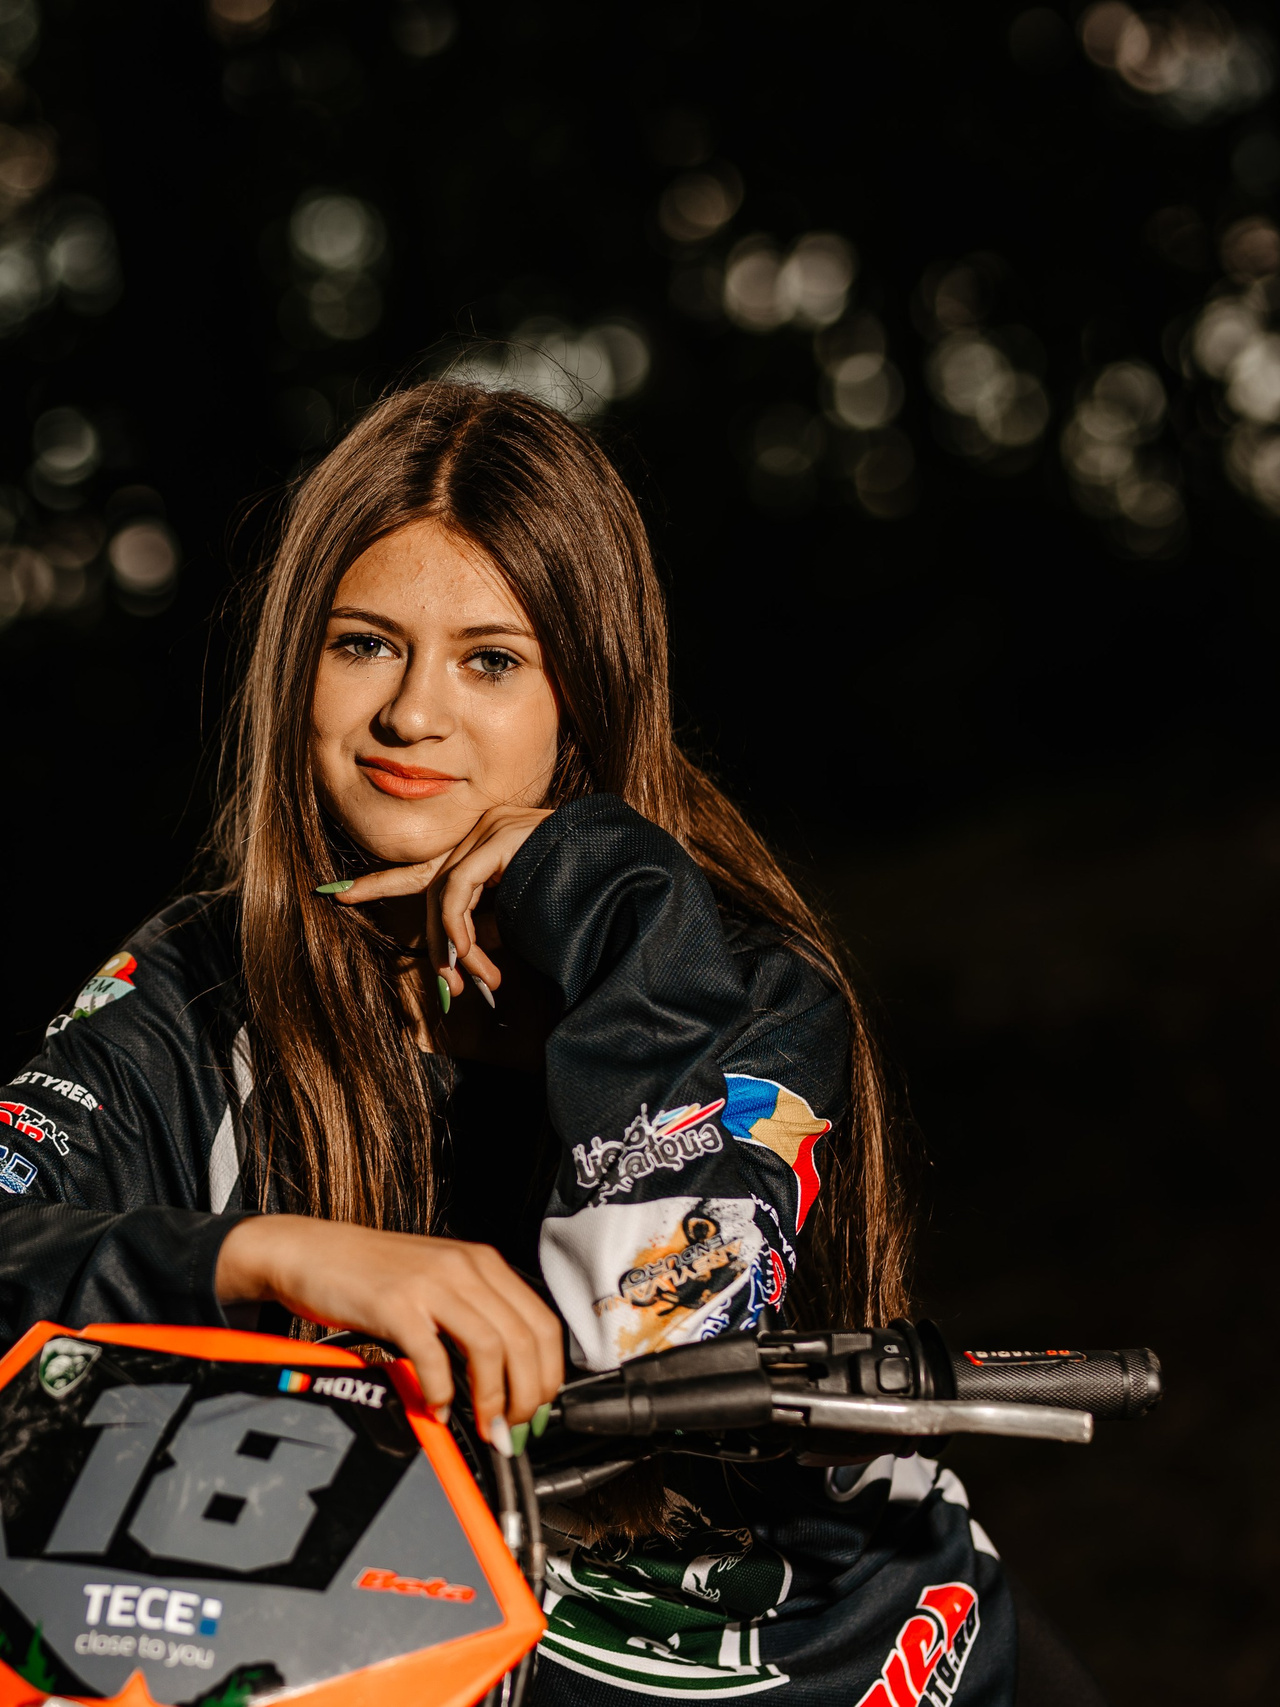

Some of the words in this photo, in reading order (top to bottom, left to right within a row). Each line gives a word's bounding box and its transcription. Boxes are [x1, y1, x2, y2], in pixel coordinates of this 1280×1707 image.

[7, 1071, 99, 1112] STYRES
[312, 1376, 387, 1409] ROXI
[43, 1383, 357, 1573] 18
[352, 1566, 477, 1604] Beta
[74, 1629, 137, 1658] close
[138, 1633, 166, 1660] to
[163, 1641, 216, 1670] you
